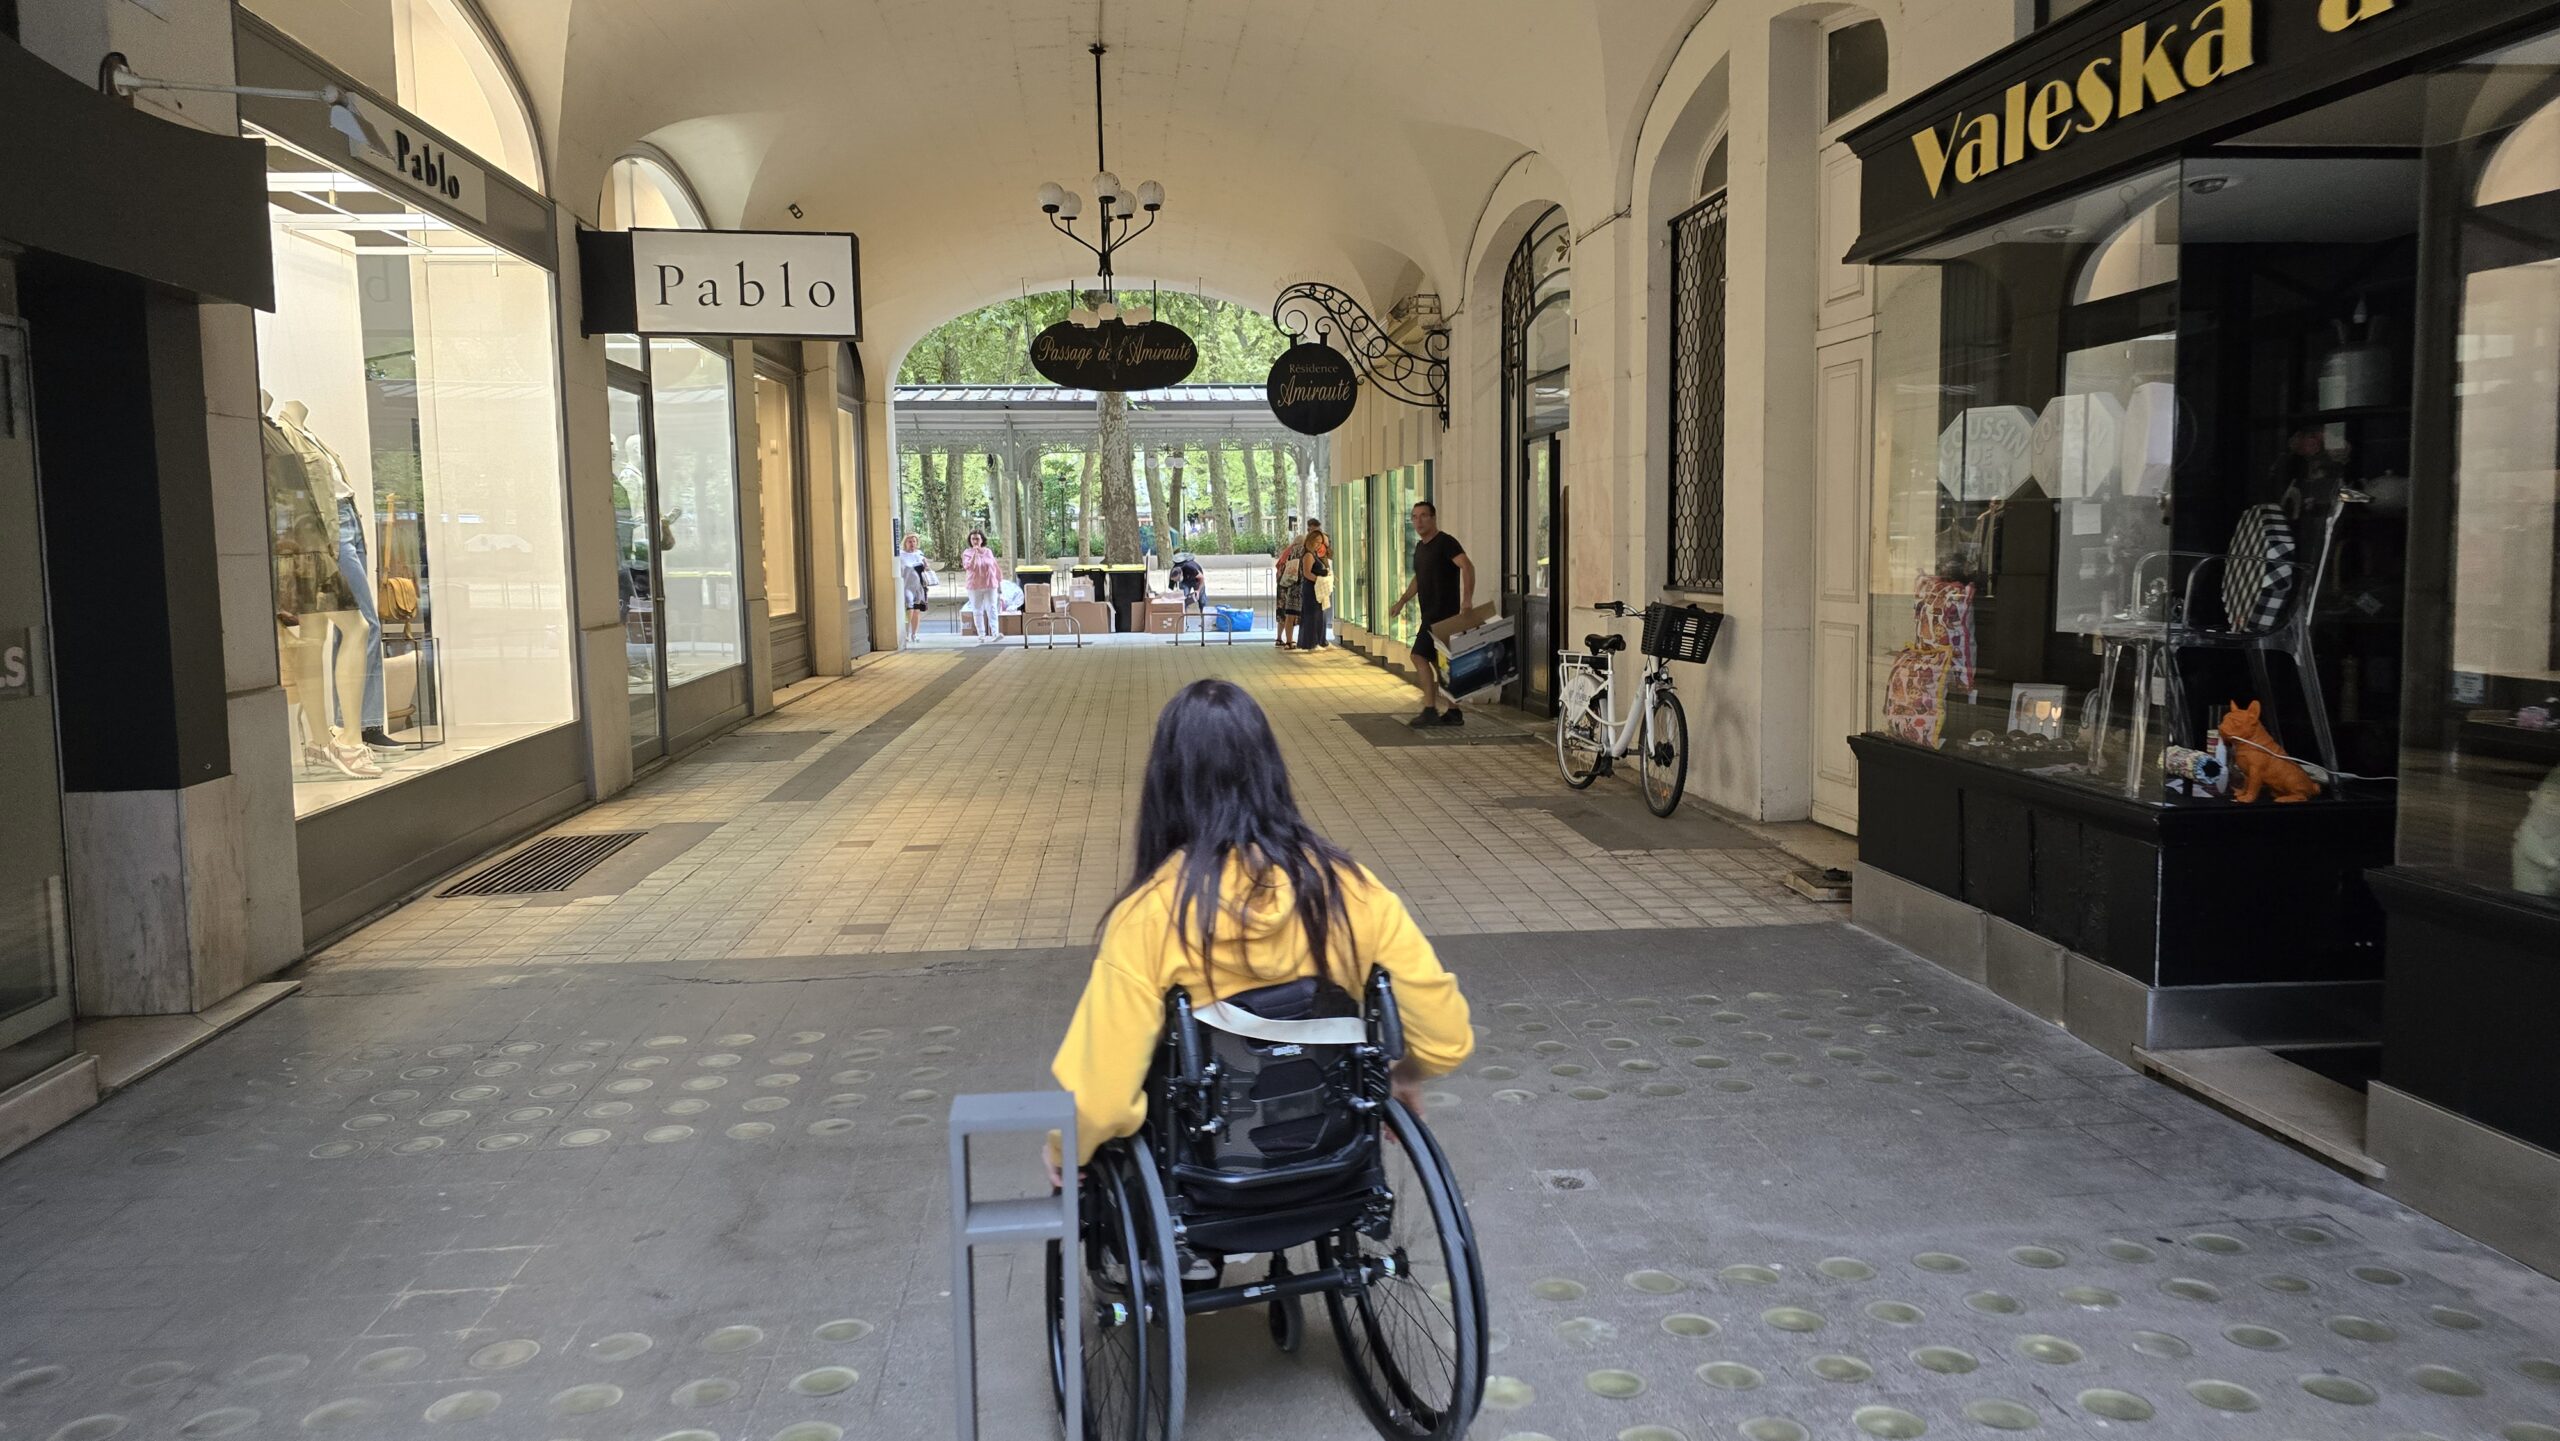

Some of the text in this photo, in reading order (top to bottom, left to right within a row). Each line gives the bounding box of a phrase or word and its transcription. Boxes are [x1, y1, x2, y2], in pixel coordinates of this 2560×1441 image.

[1911, 0, 2255, 199] Valeska
[395, 129, 460, 199] Pablo
[653, 260, 836, 308] Pablo
[1038, 335, 1093, 370] Passage
[1289, 363, 1340, 374] Résidence
[1277, 374, 1351, 407] Amirauté
